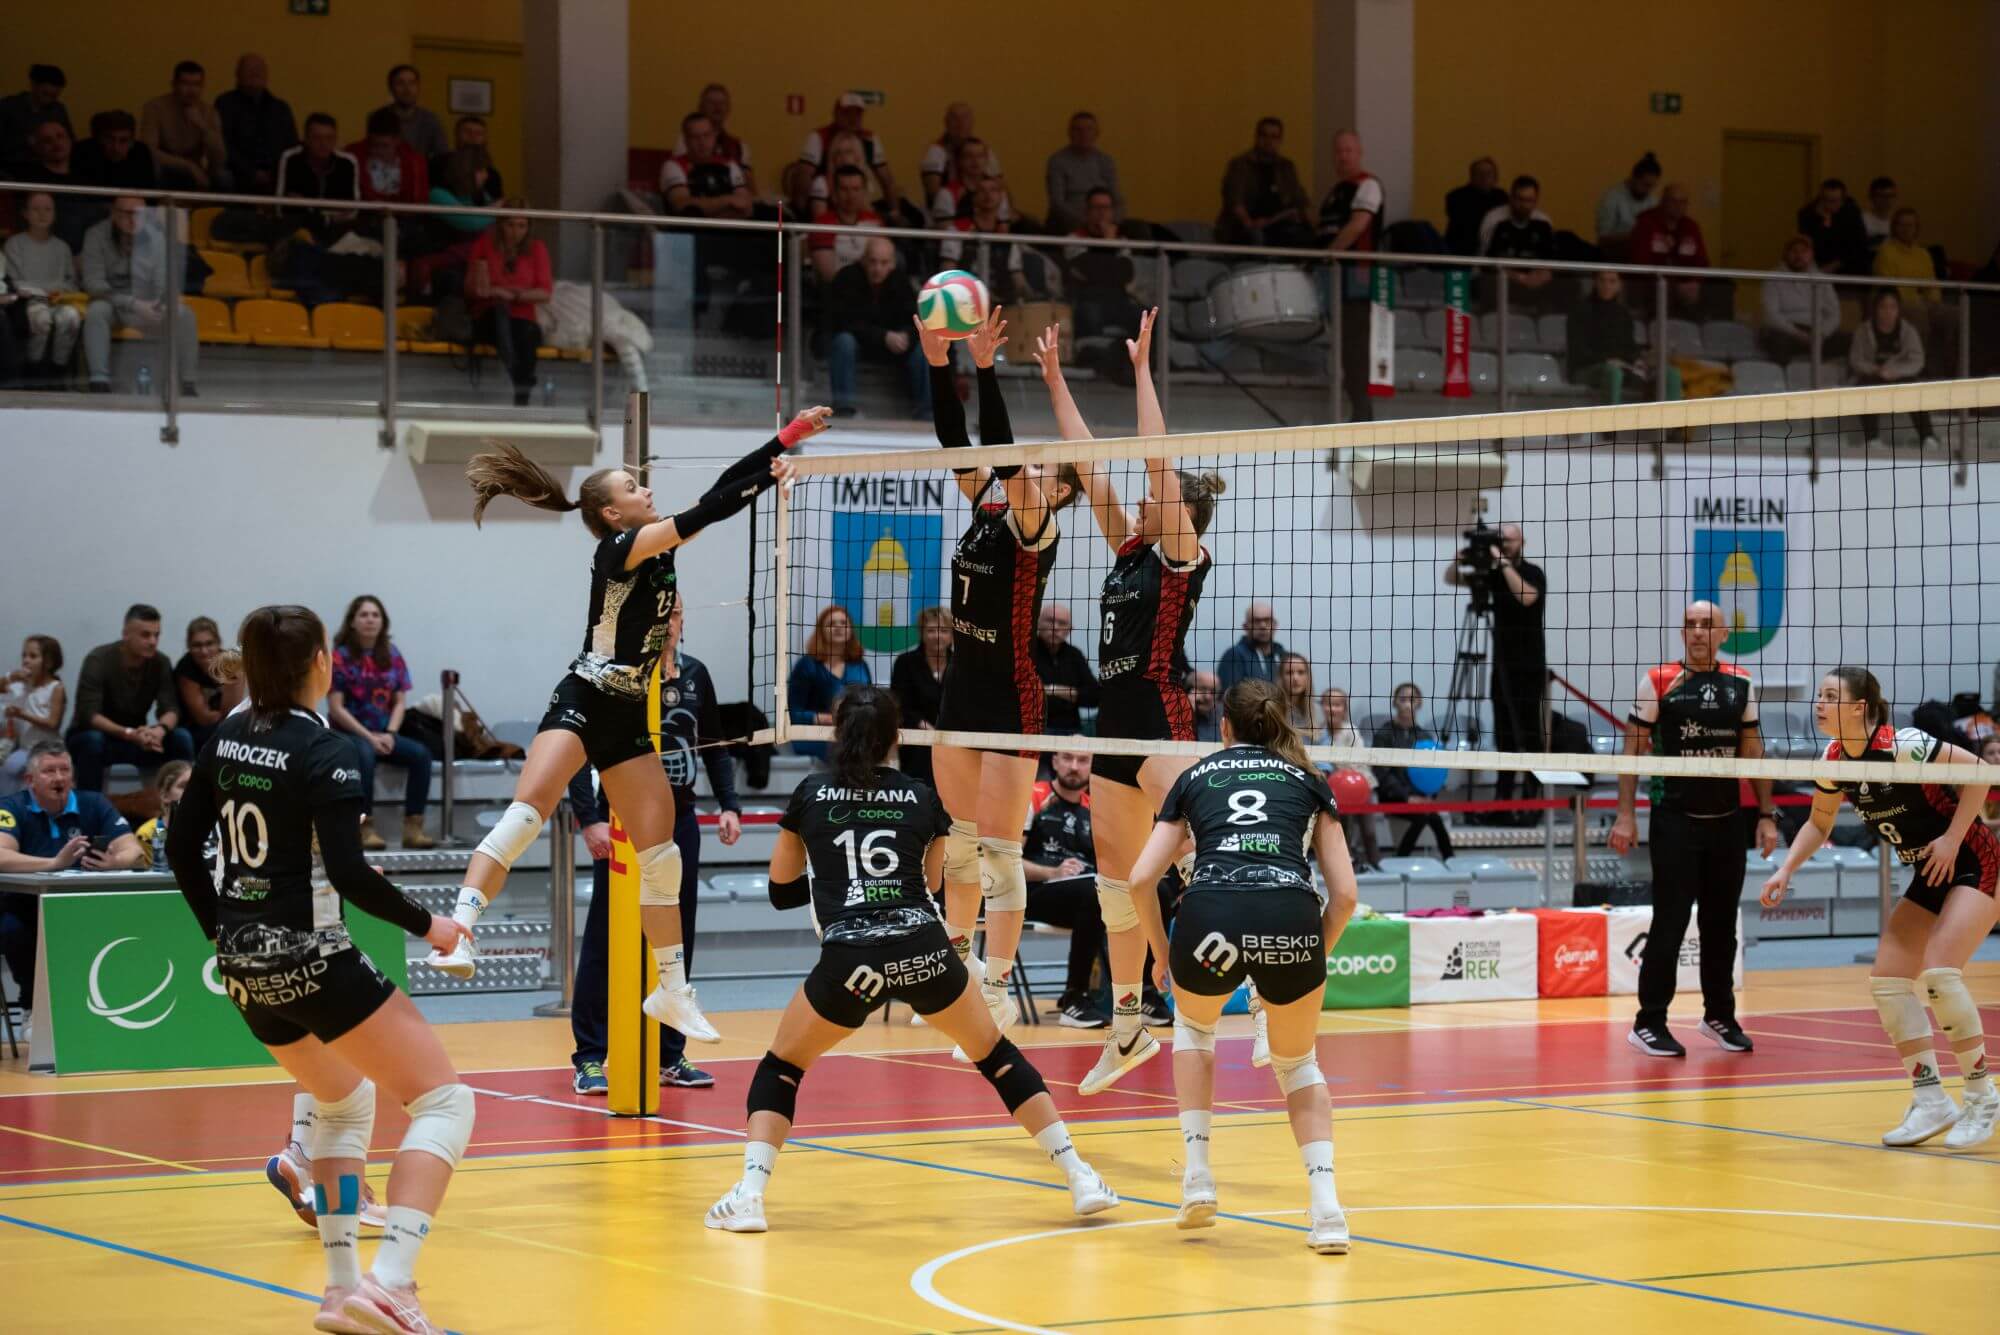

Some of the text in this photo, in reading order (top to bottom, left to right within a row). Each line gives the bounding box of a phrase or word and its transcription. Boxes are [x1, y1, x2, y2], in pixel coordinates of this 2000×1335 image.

[832, 476, 943, 507] IMIELIN
[1694, 496, 1784, 524] IMIELIN
[959, 573, 970, 605] 7
[1103, 611, 1115, 645] 6
[216, 739, 290, 771] MROCZEK
[238, 773, 272, 791] COPCO
[1190, 759, 1306, 781] MACKIEWICZ
[1238, 772, 1287, 782] COPCO
[815, 785, 919, 804] ŚMIETANA
[1226, 789, 1268, 826] 8
[857, 809, 903, 820] COPCO
[220, 799, 269, 868] 10
[832, 829, 900, 879] 16
[865, 886, 903, 902] REK
[1242, 934, 1320, 948] BESKID
[883, 949, 948, 975] BESKID
[1243, 950, 1312, 965] MEDIA
[1326, 954, 1397, 976] COPCO
[1466, 960, 1500, 979] REK
[245, 959, 328, 990] BESKID
[886, 962, 947, 989] MEDIA
[251, 980, 321, 1006] MEDIA
